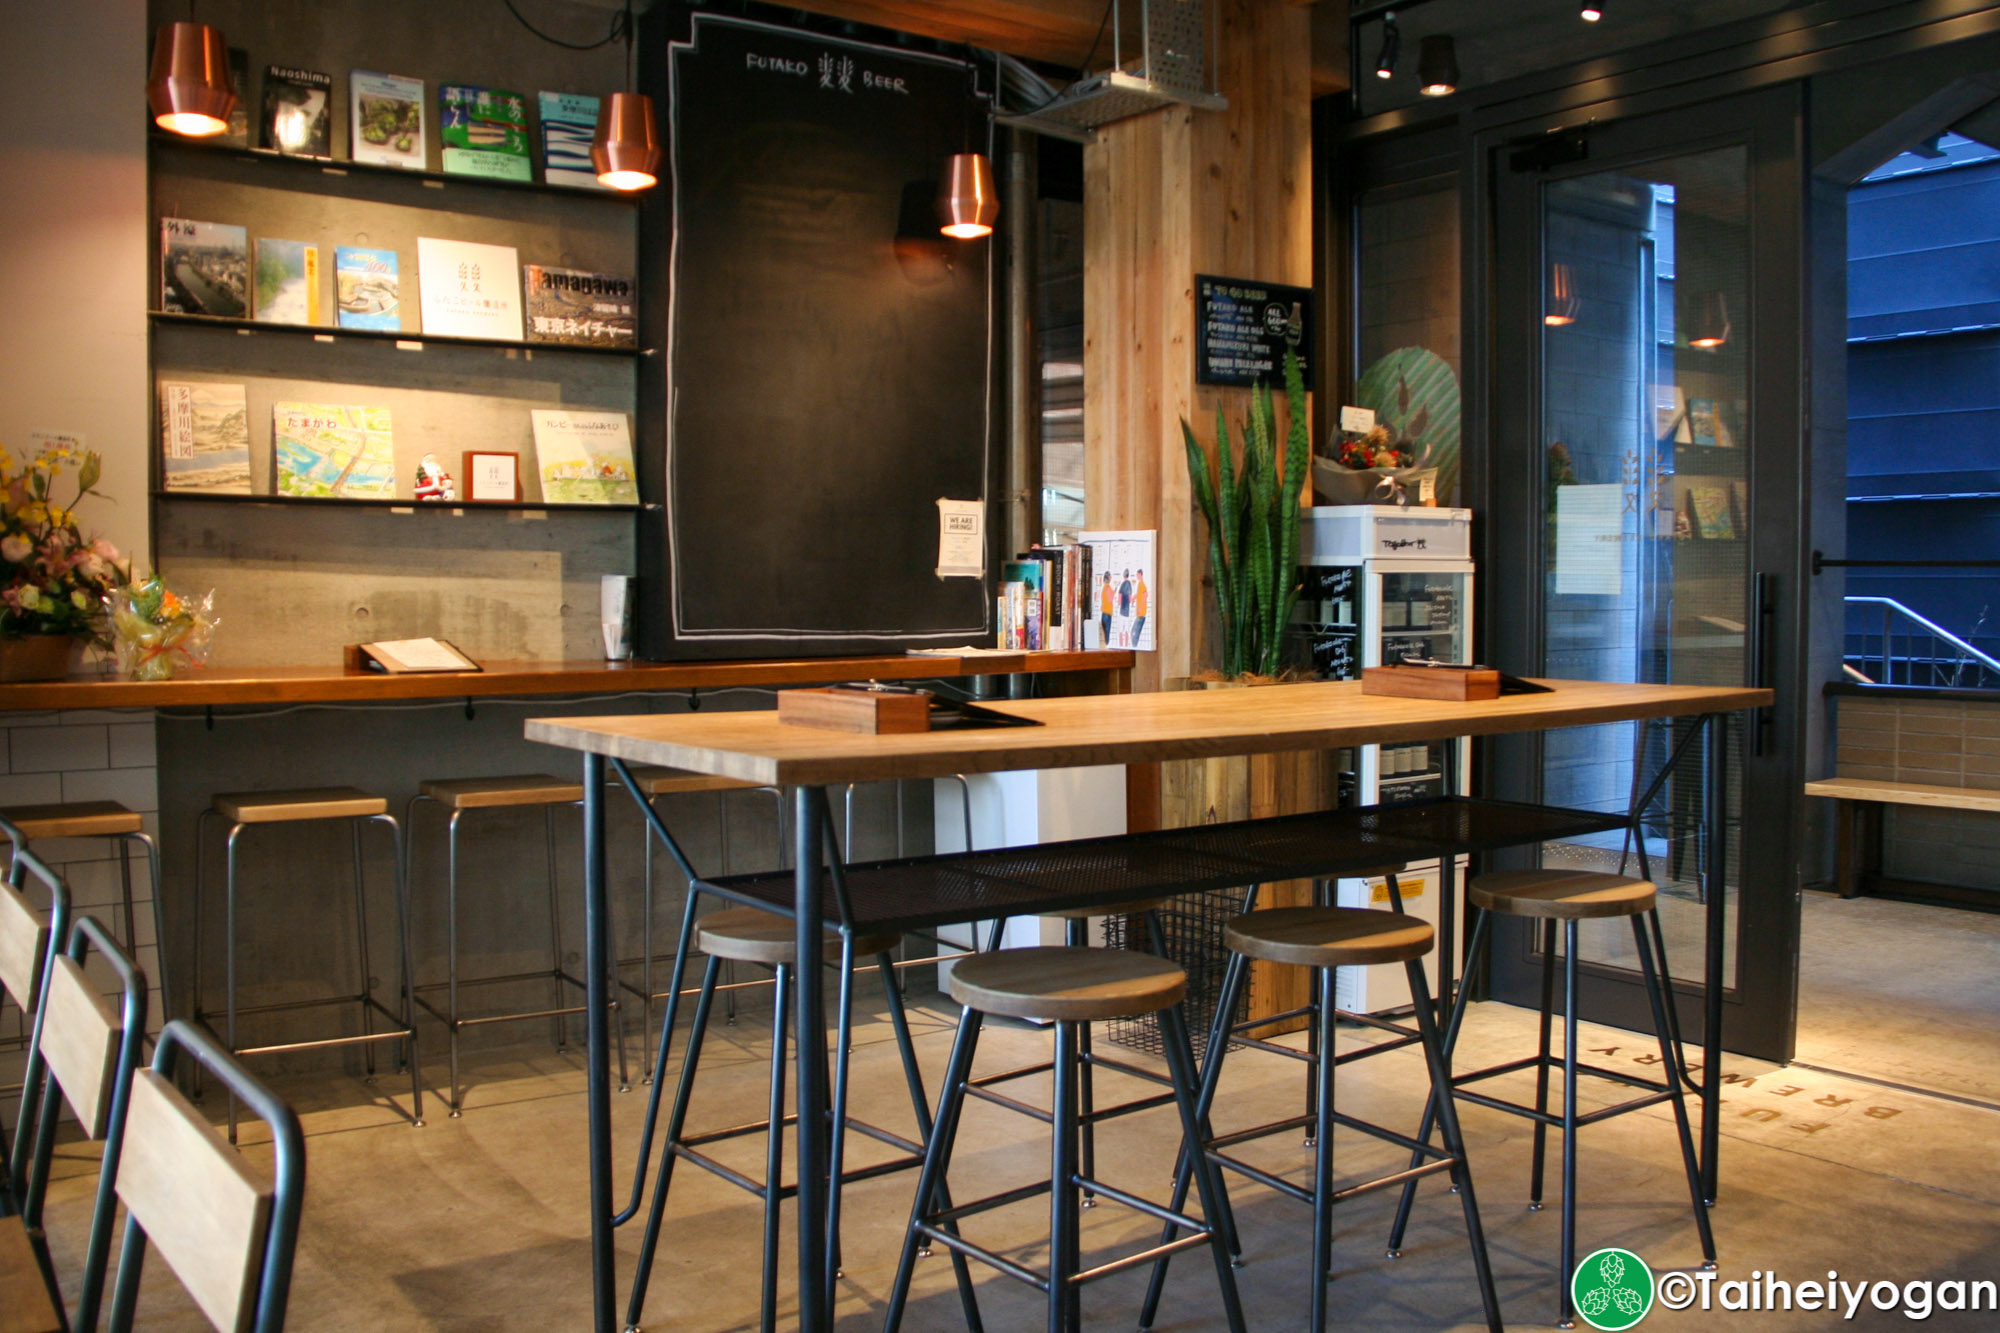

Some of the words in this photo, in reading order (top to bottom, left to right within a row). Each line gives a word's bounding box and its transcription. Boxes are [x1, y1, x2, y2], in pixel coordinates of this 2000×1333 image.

[270, 66, 331, 84] Naoshima
[746, 52, 808, 76] FUTAKO
[863, 71, 909, 94] BEER
[528, 264, 629, 297] Tamagawa
[533, 316, 633, 339] 東京ネイチャー
[177, 388, 193, 457] 多摩川絵図
